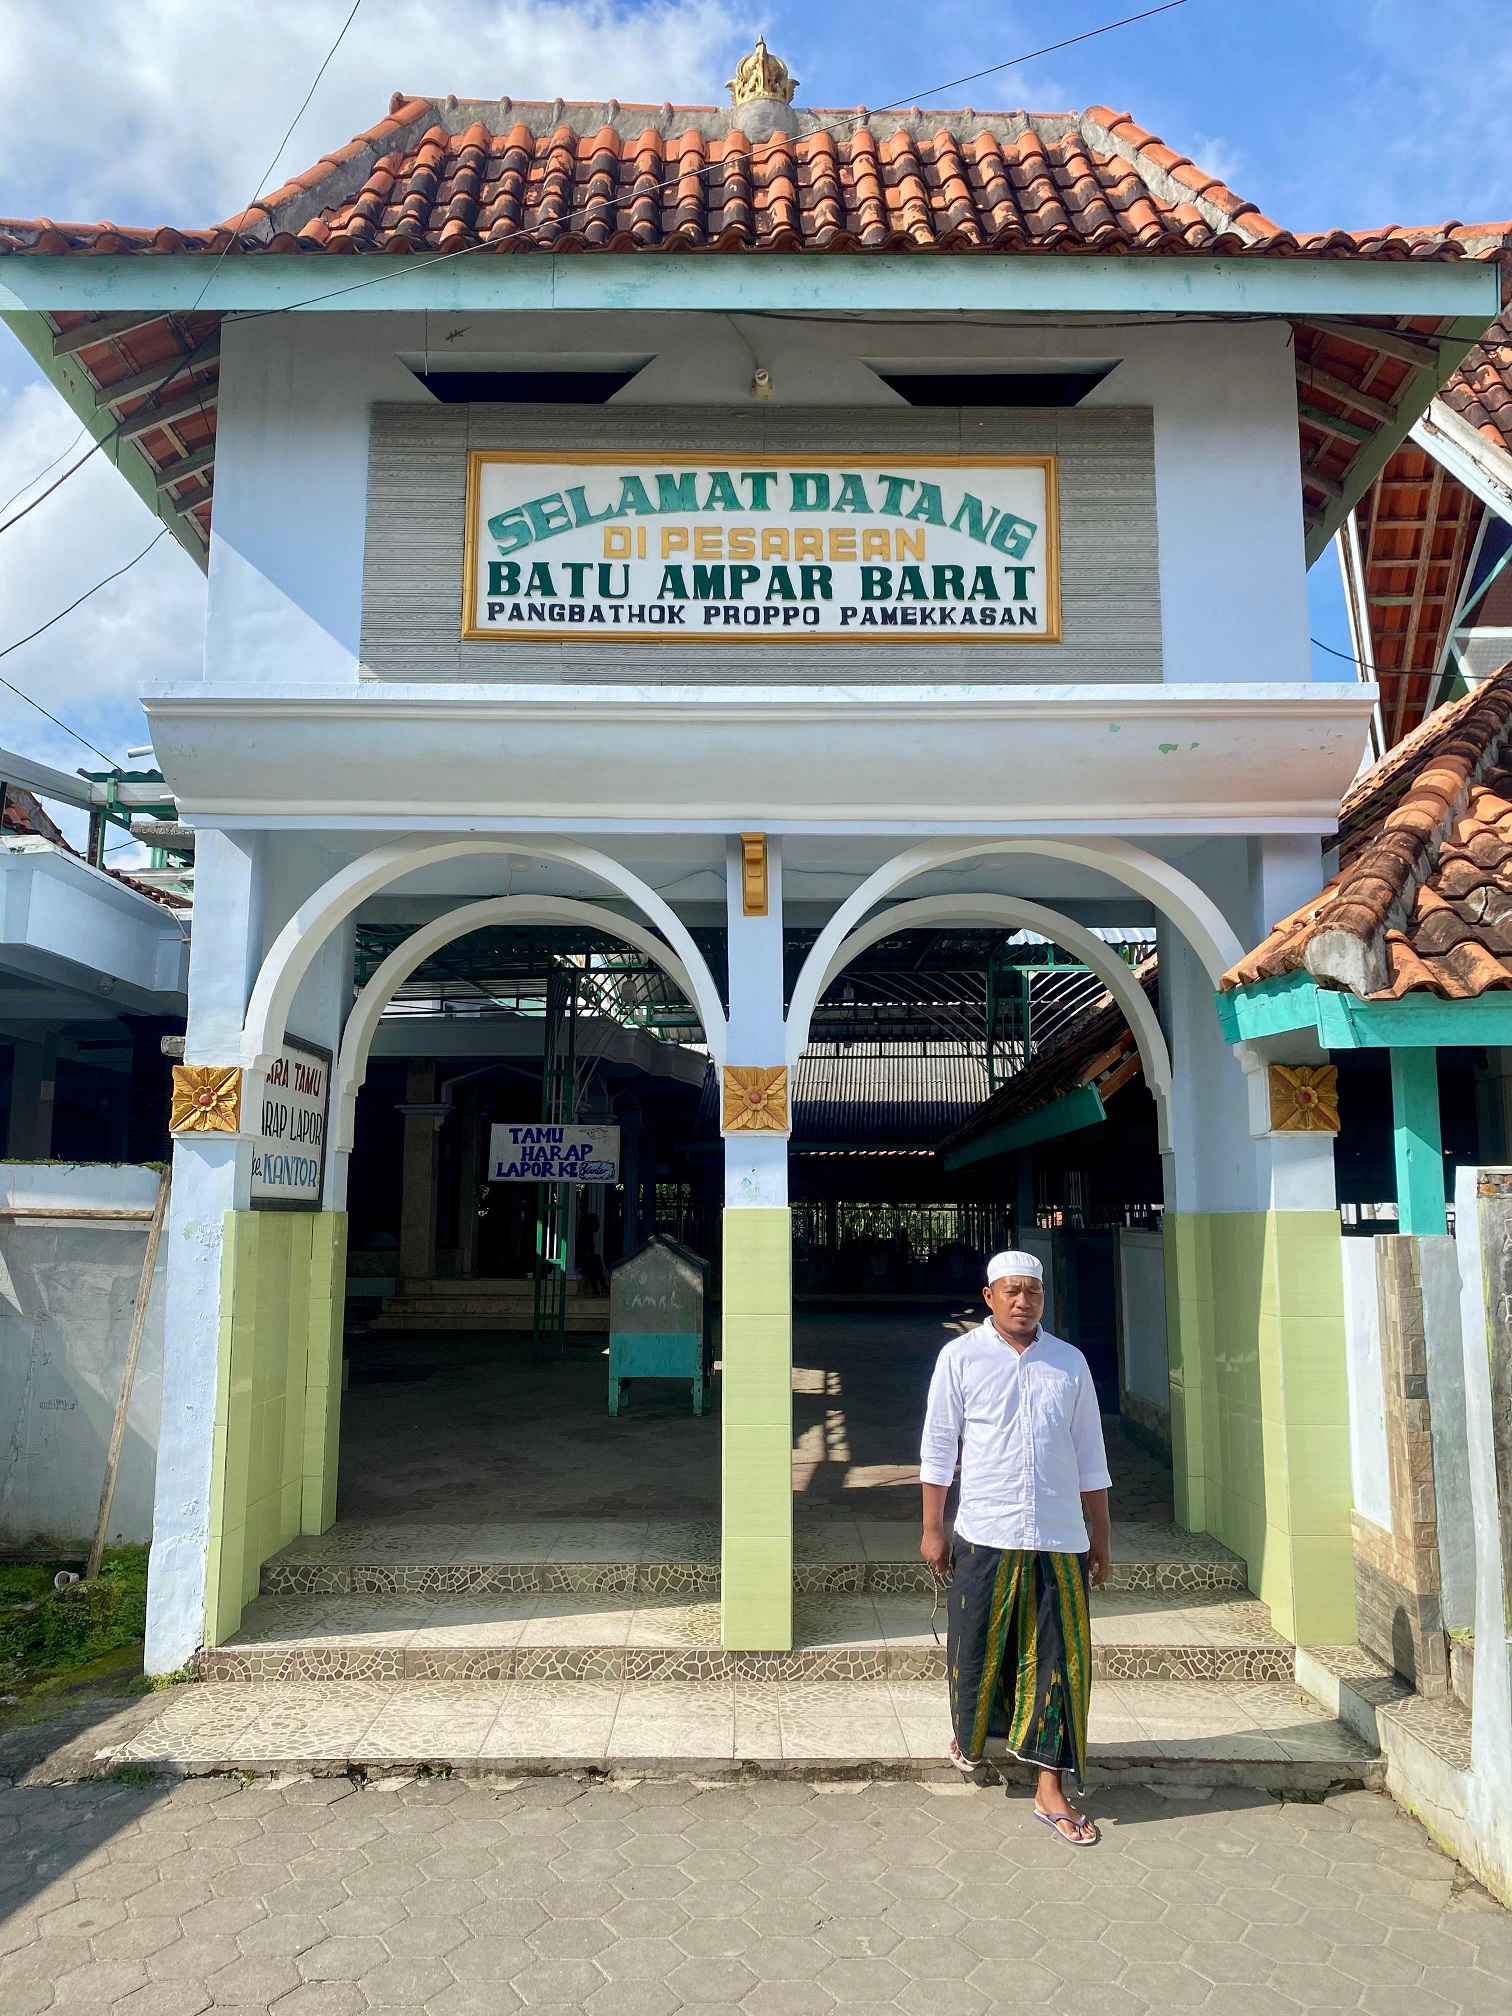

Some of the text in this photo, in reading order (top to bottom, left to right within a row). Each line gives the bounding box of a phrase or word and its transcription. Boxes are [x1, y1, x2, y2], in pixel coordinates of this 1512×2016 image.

[487, 471, 1038, 561] SELAMAT DATANG
[603, 526, 926, 562] DI PESAREAN
[487, 561, 1036, 601] BATU AMPAR BARAT
[487, 602, 1038, 627] PANGBATHOK PROPPO PAMEKKASAN
[295, 1062, 322, 1097] TAMU
[290, 1106, 323, 1145] LAPOR
[508, 1127, 565, 1144] TAMU
[496, 1162, 556, 1178] LAPOR
[558, 1162, 578, 1178] KE
[521, 1144, 594, 1161] HARAP
[263, 1153, 317, 1188] KANTOR
